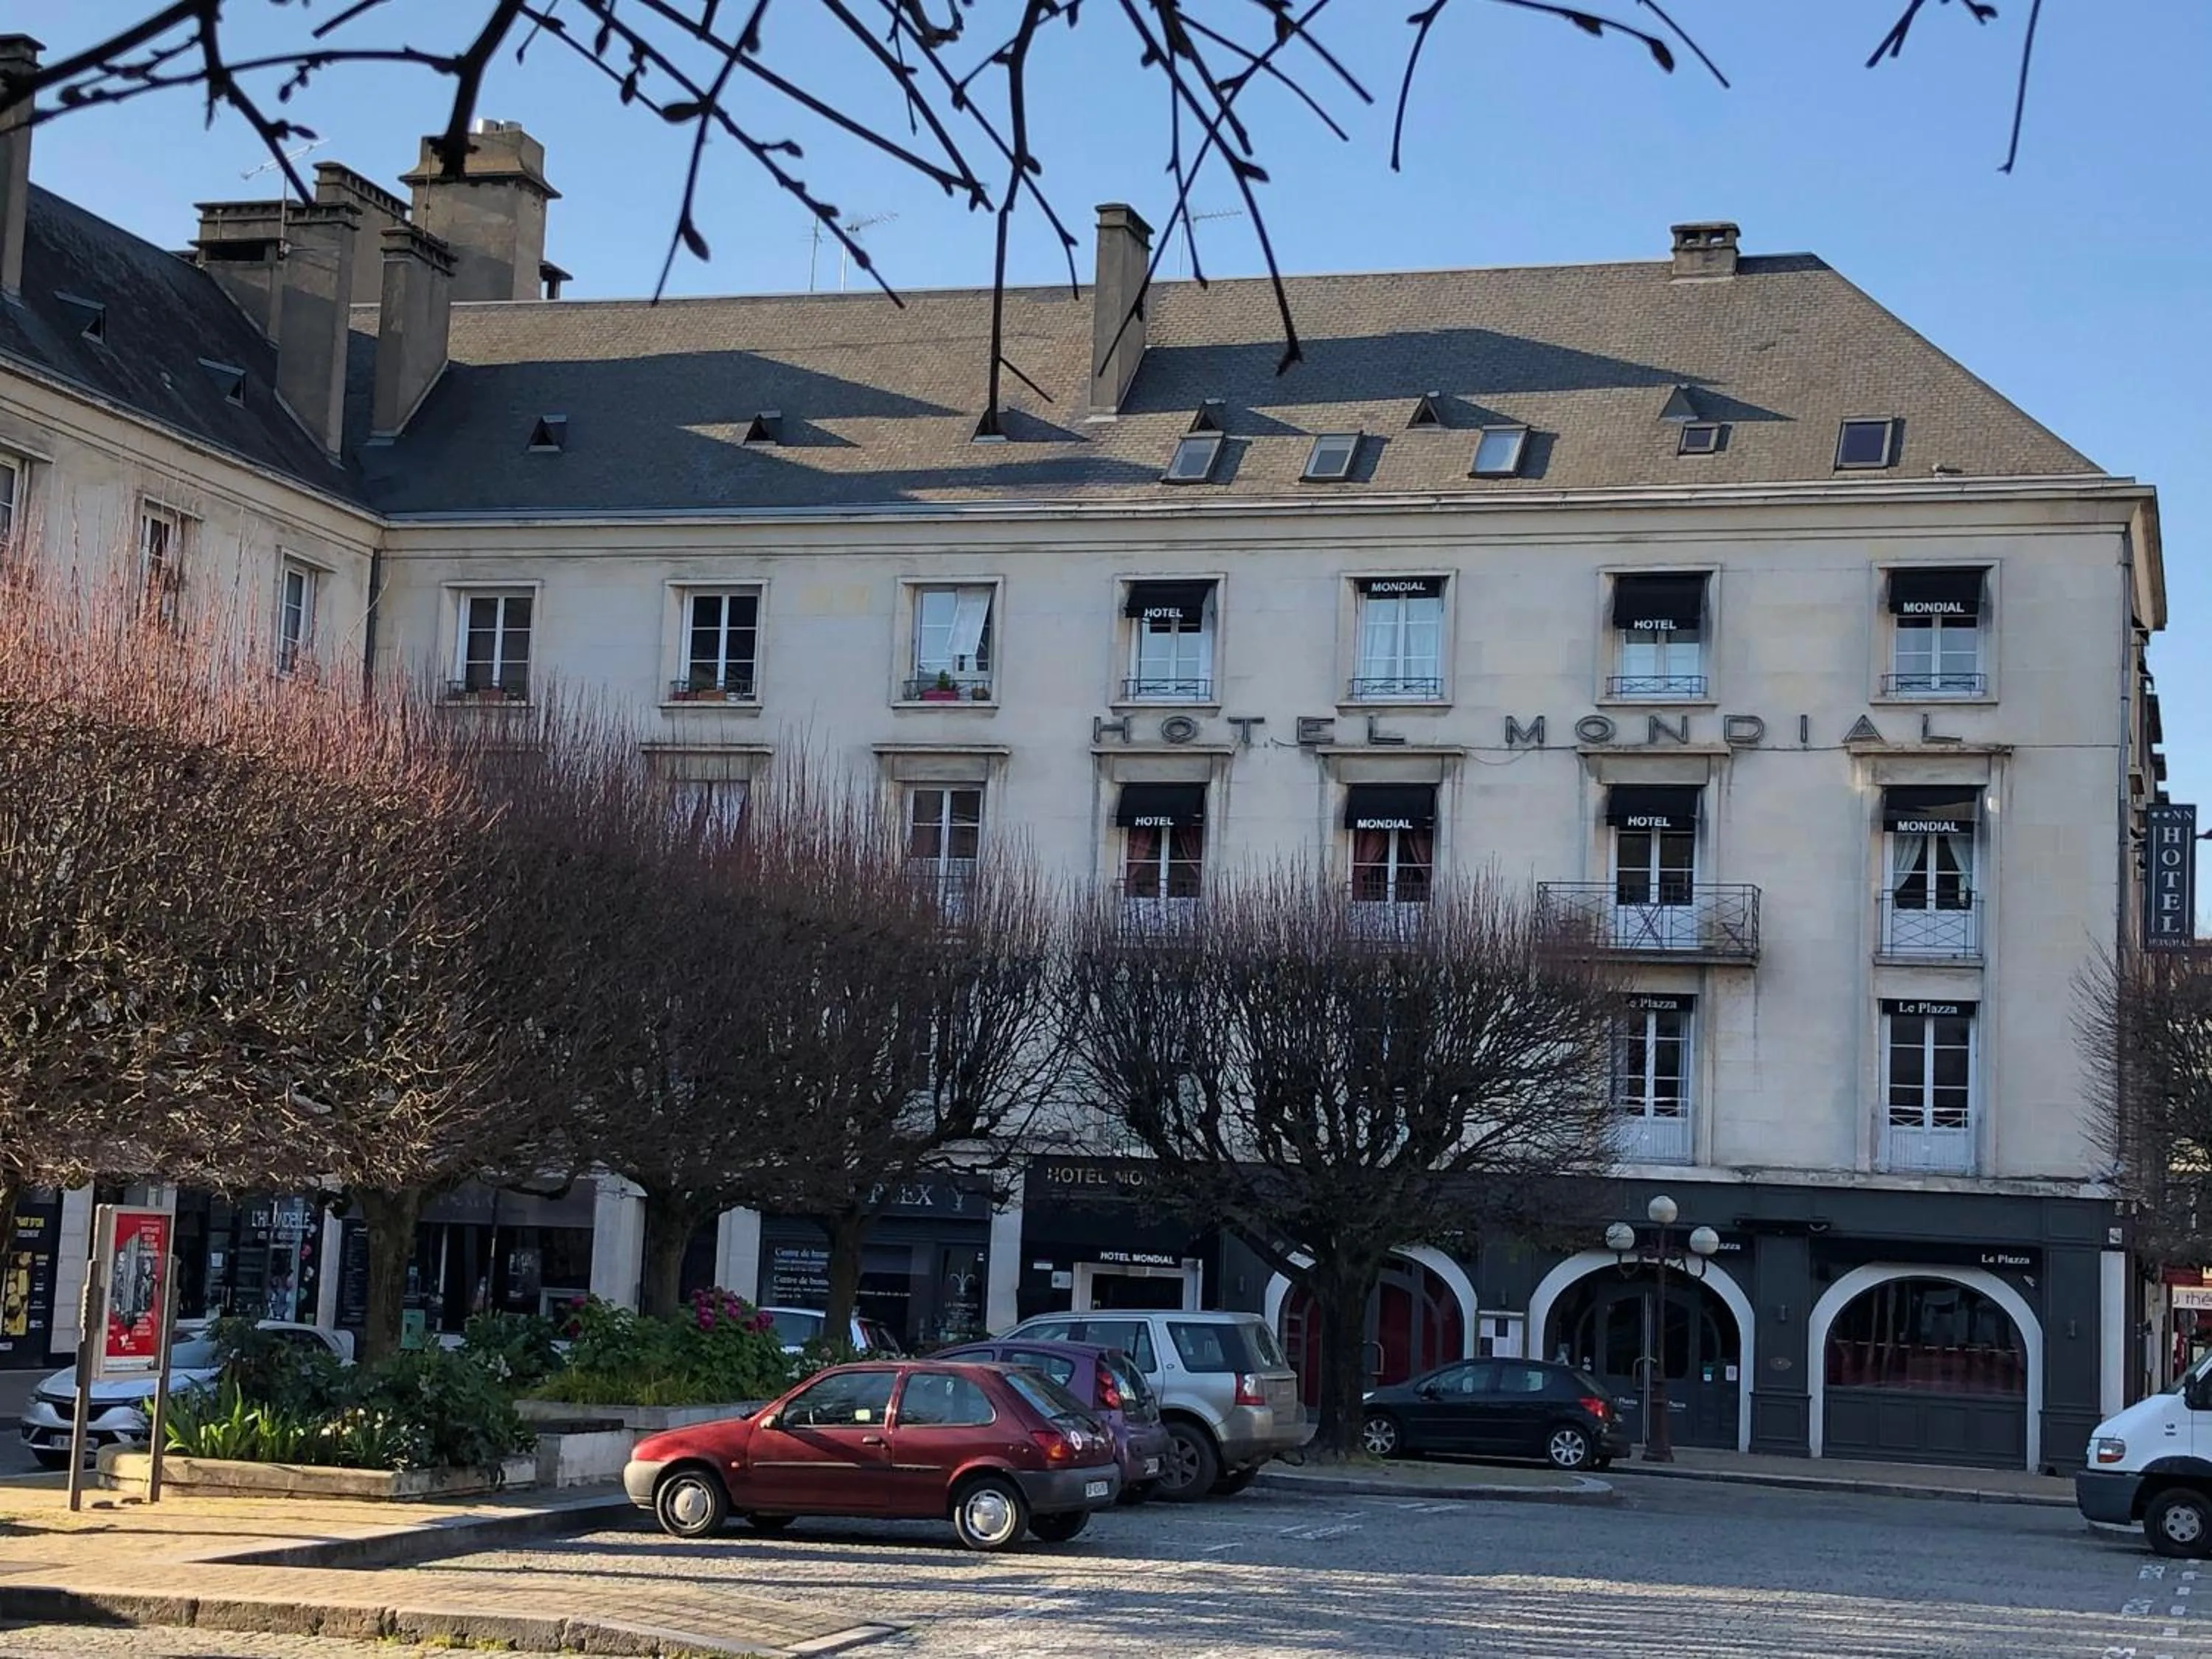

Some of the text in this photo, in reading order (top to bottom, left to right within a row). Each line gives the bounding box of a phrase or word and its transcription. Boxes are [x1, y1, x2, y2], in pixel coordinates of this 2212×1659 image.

[1371, 582, 1426, 592] MONDIAL
[1144, 607, 1183, 618] HOTEL
[1903, 601, 1965, 613] MONDIAL
[1633, 619, 1677, 630] HOTEL
[1093, 714, 1962, 745] HOTEL MONDIAL
[1134, 815, 1175, 827] HOTEL
[1357, 818, 1413, 830] MONDIAL
[1627, 815, 1671, 827] HOTEL
[1896, 820, 1959, 832] MONDIAL
[2160, 827, 2181, 933] HOTEL
[1899, 1001, 1915, 1013] Le
[1046, 1167, 1108, 1184] HOTEL
[1100, 1251, 1175, 1265] HOTEL MONDIAL
[1981, 1253, 1994, 1263] Le
